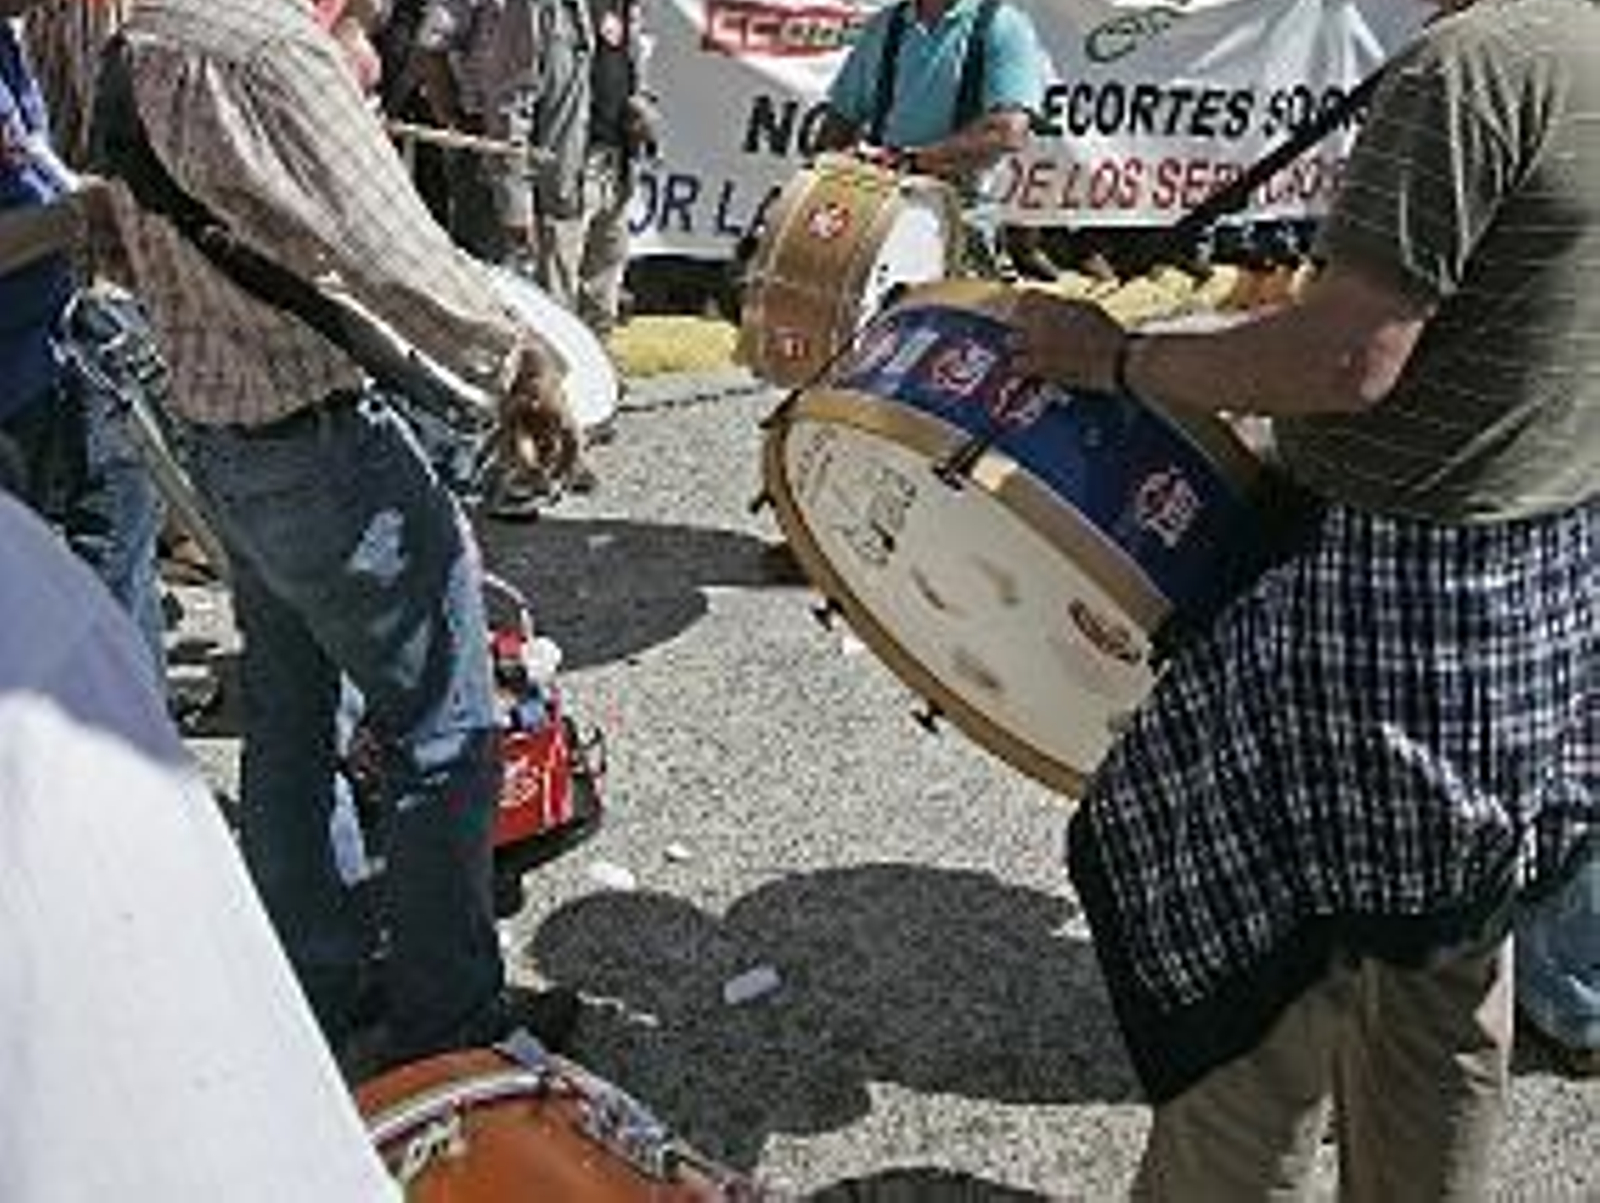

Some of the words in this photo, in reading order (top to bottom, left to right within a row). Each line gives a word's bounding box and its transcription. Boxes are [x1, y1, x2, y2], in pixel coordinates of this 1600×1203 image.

[1034, 83, 1252, 138] ECORTES
[628, 174, 703, 233] OR
[1061, 159, 1143, 210] LOS
